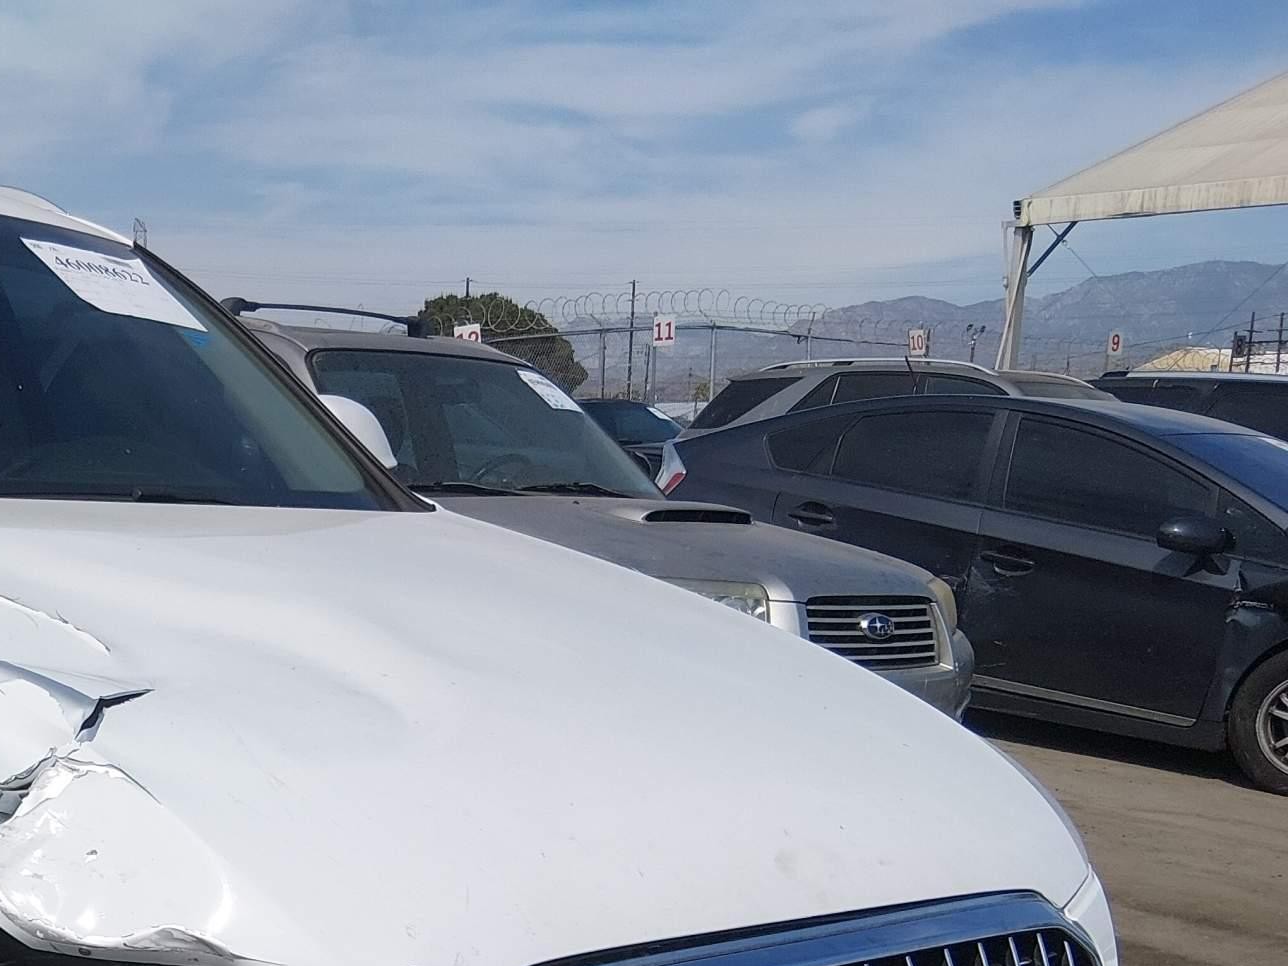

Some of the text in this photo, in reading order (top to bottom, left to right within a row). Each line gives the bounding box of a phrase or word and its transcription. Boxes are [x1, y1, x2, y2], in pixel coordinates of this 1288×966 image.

[54, 255, 150, 286] 46008622
[654, 321, 674, 341] 11
[910, 334, 924, 351] 10
[1111, 333, 1120, 352] 9
